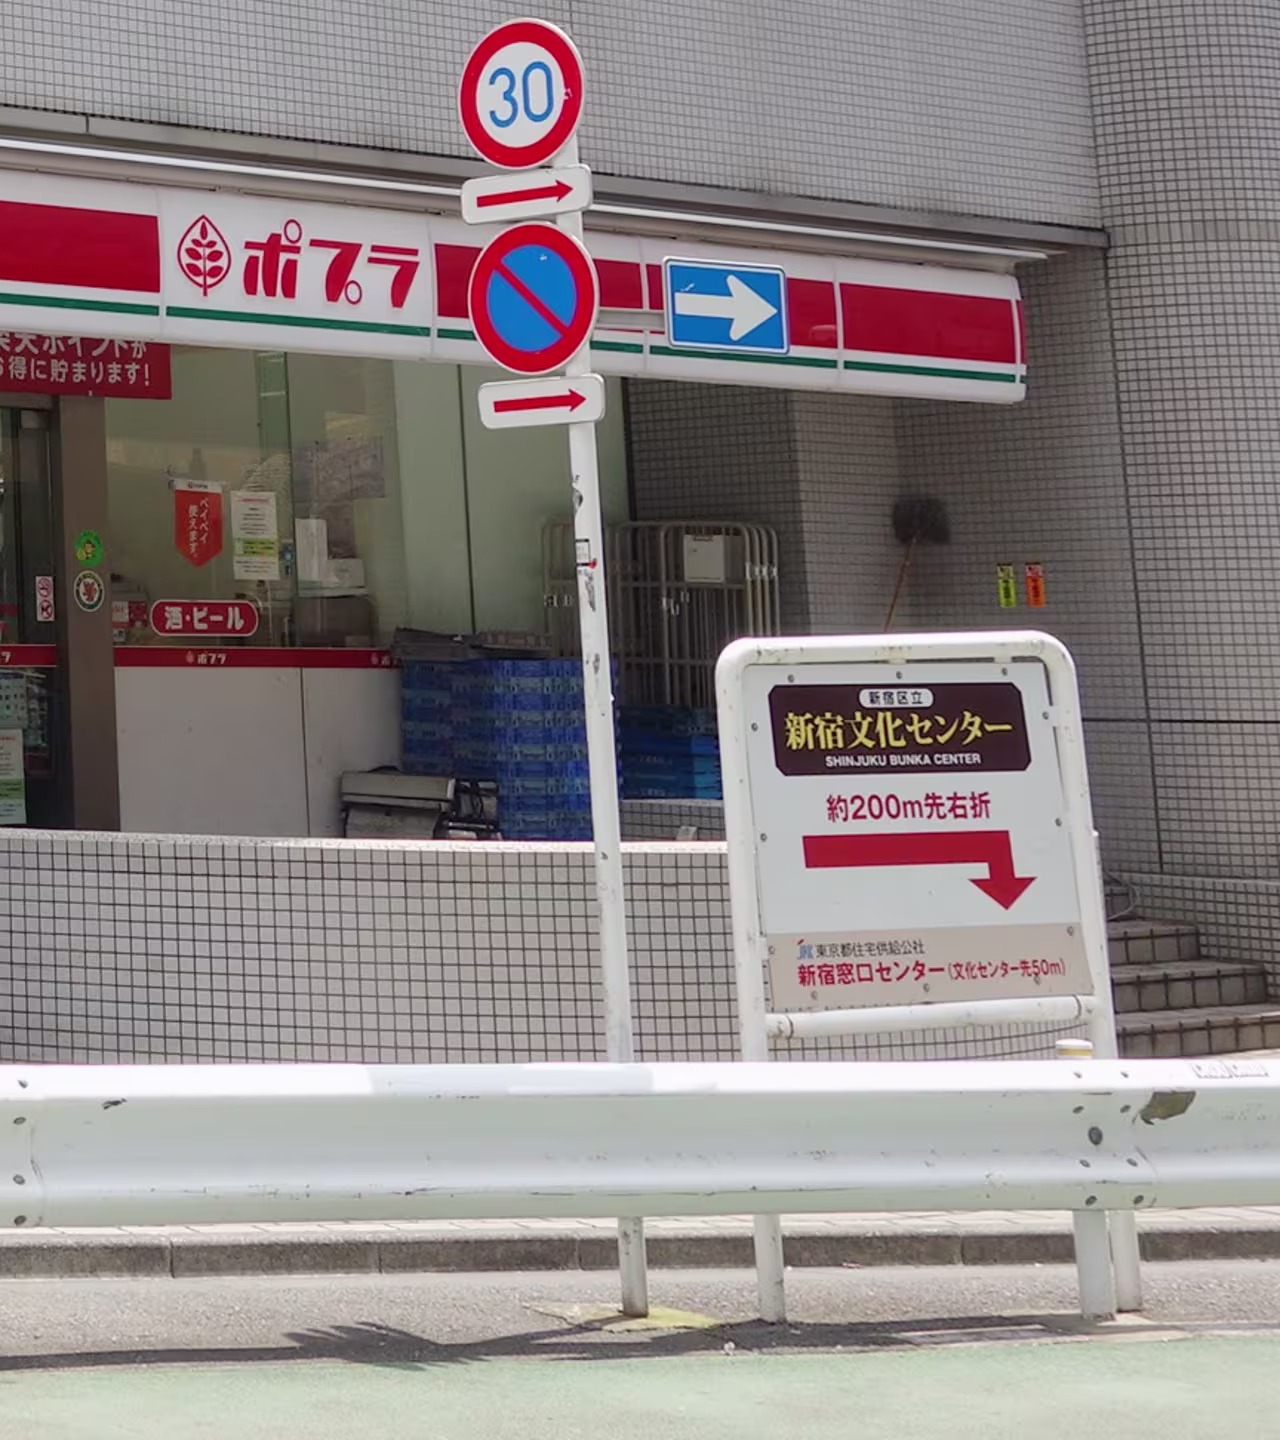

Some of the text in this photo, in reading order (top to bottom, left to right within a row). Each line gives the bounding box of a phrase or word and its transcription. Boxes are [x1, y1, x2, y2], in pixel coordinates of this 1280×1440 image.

[489, 61, 554, 128] 30
[243, 219, 419, 309] ポプラ
[164, 606, 245, 631] 酒・ビール
[869, 691, 923, 705] 新宿区立
[785, 711, 1013, 751] 新宿文化センター
[825, 753, 981, 767] SHINJUKU BUNKA CENTER
[826, 791, 992, 824] 約200m先右折
[815, 939, 926, 958] 東京都住宅供給公社
[797, 960, 946, 987] 新宿窓口センター
